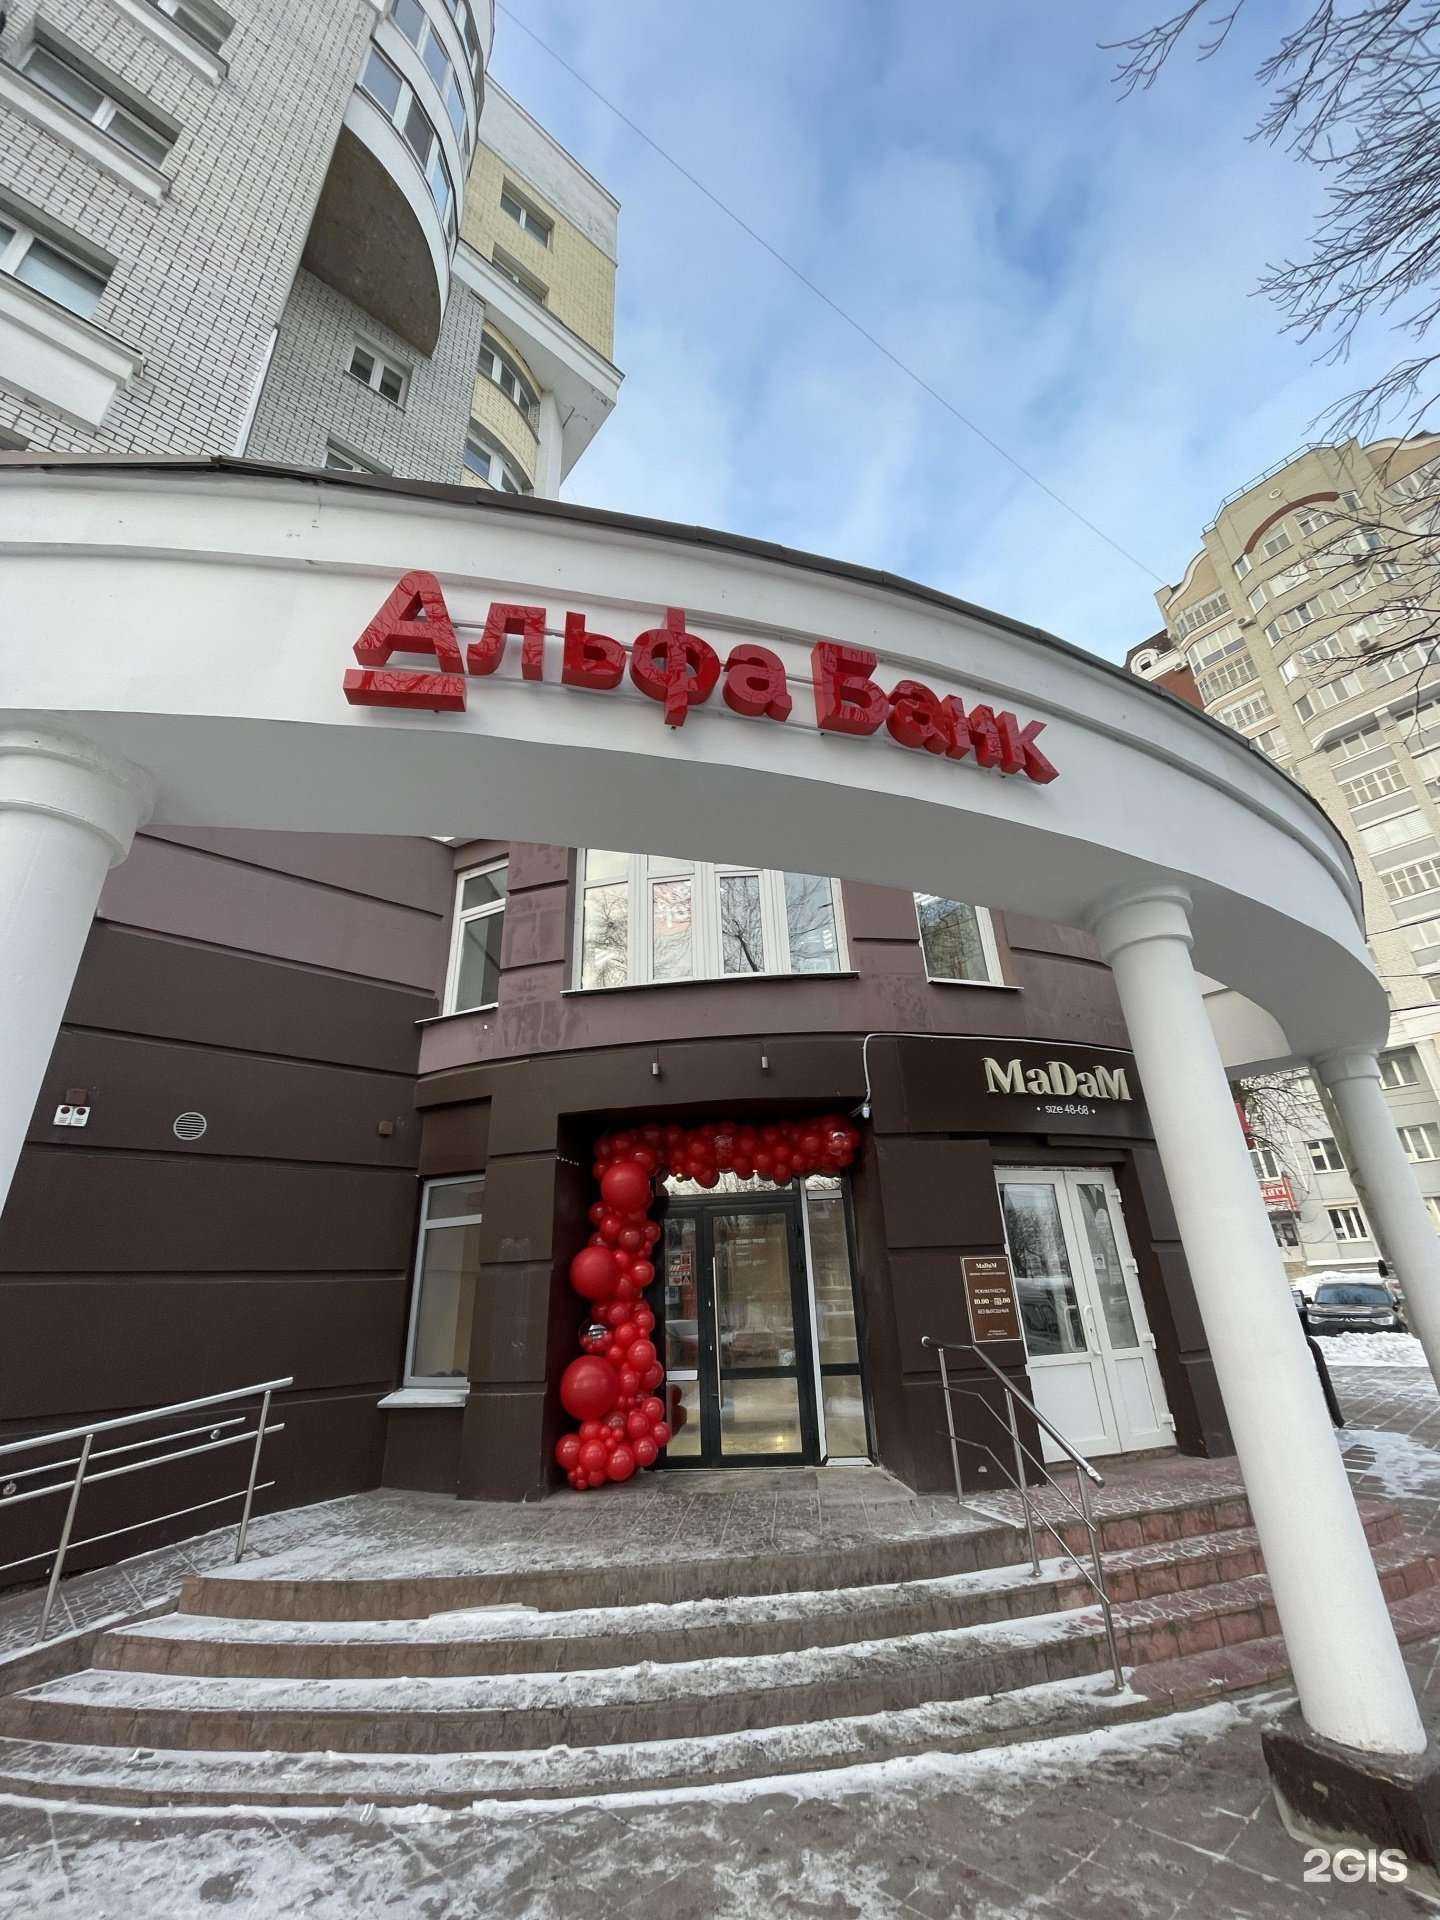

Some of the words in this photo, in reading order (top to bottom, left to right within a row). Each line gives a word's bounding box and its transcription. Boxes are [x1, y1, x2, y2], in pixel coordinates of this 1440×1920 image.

[351, 569, 793, 728] Альфа
[811, 641, 1060, 785] Банк
[982, 1057, 1133, 1101] MaDaM
[1045, 1105, 1063, 1114] size
[1065, 1104, 1089, 1115] 48-68
